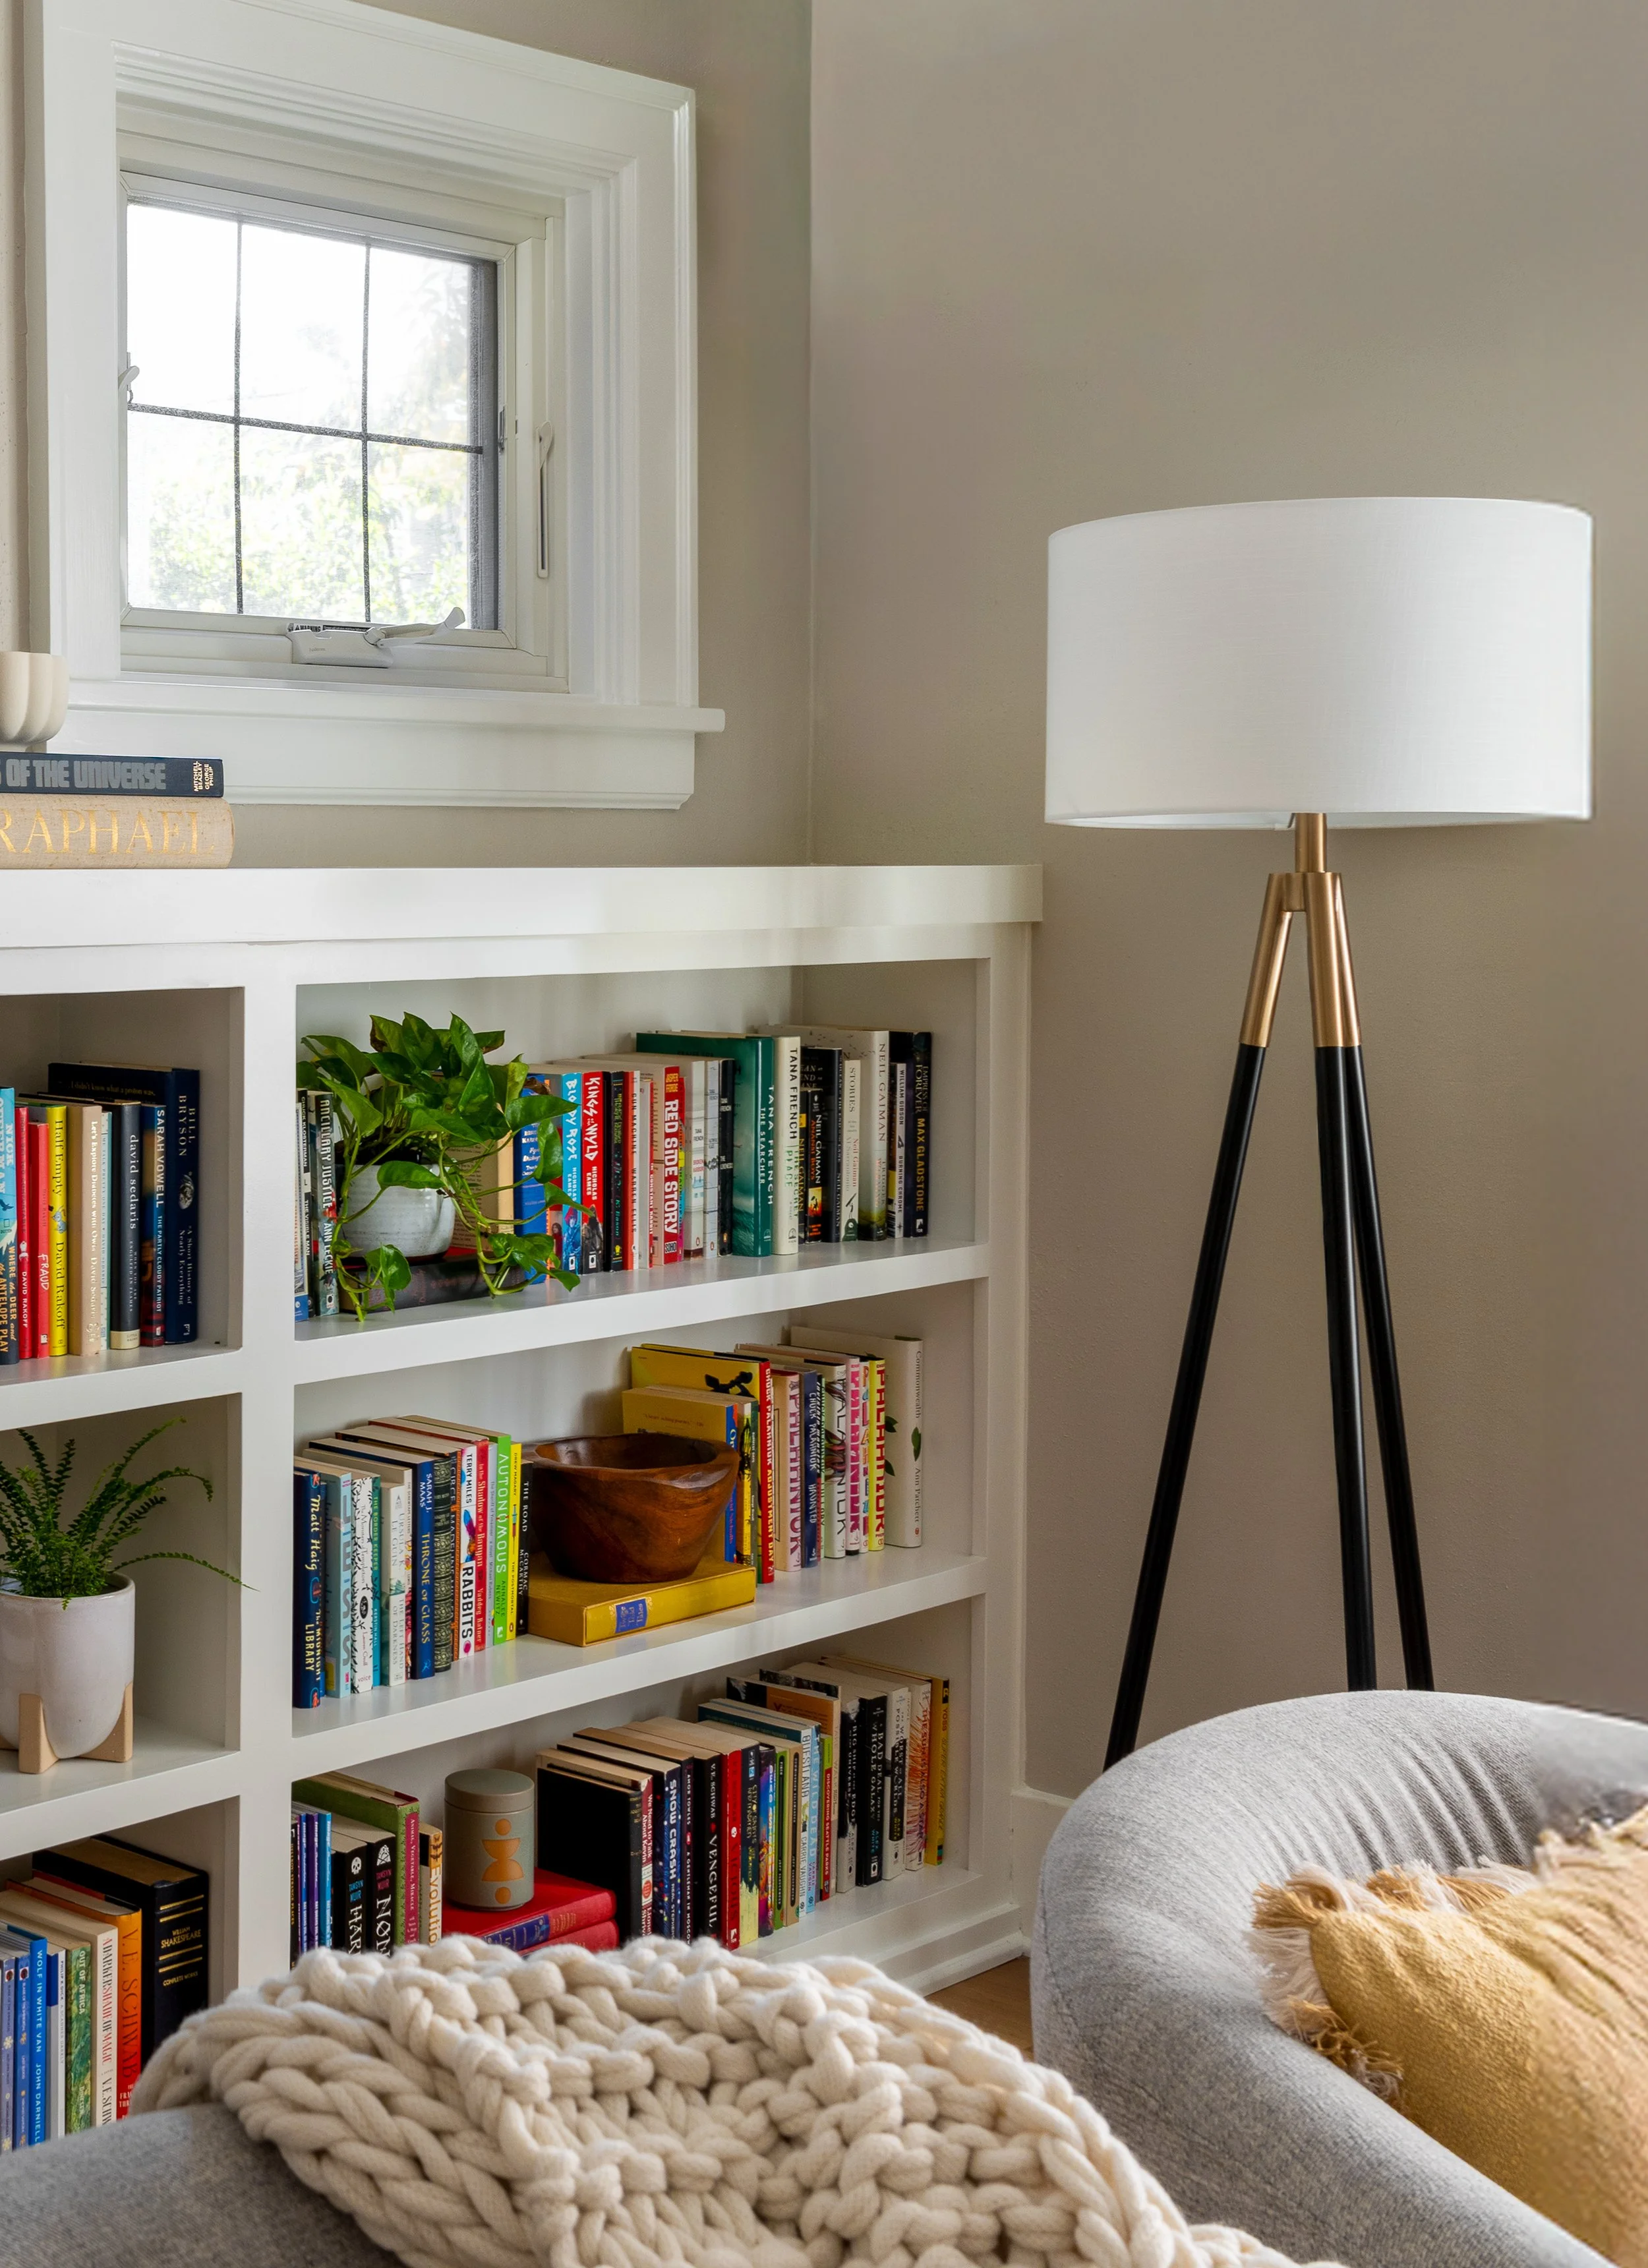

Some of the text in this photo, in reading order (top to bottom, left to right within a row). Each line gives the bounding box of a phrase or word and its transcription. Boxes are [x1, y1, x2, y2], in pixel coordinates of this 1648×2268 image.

[6, 759, 166, 790] OF THE UNIVERSE
[179, 1095, 187, 1156] BRYSON
[664, 1099, 679, 1133] RED
[5, 1123, 14, 1166] NICK
[52, 1120, 64, 1196] Half Empty
[320, 1099, 333, 1209] ANCILLARY JUSTICE
[129, 1135, 139, 1229] david sedaris
[156, 1156, 165, 1209] VOWELL
[916, 1146, 925, 1212] GLADSTONE
[664, 1181, 678, 1234] STORY
[38, 1253, 49, 1290] FRAUD
[324, 1222, 334, 1274] ANN LECKIE
[9, 1282, 17, 1294] the
[56, 1241, 65, 1329] David Rakoff
[790, 1393, 801, 1555] PALAHNIUK
[496, 1453, 509, 1573] AUTONOMOUS
[808, 1483, 817, 1524] HAUNTED
[305, 1495, 321, 1570] Matt Haig
[421, 1532, 430, 1644] THRONE OF GLASS
[461, 1565, 474, 1639] RABBITS
[305, 1624, 314, 1671] LIBRARY
[802, 1735, 811, 1798] QUESTLAND
[647, 1793, 653, 1807] We
[647, 1830, 652, 1839] to
[709, 1834, 717, 1927] VENGEFUL
[122, 1929, 138, 1947] V.
[161, 1929, 202, 1948] SHAKESPEARE
[172, 1926, 191, 1936] WILLIAM
[79, 1969, 85, 1981] OF
[122, 1951, 138, 1971] E.
[37, 1983, 42, 1992] IN
[122, 1978, 138, 2078] SCHWAB
